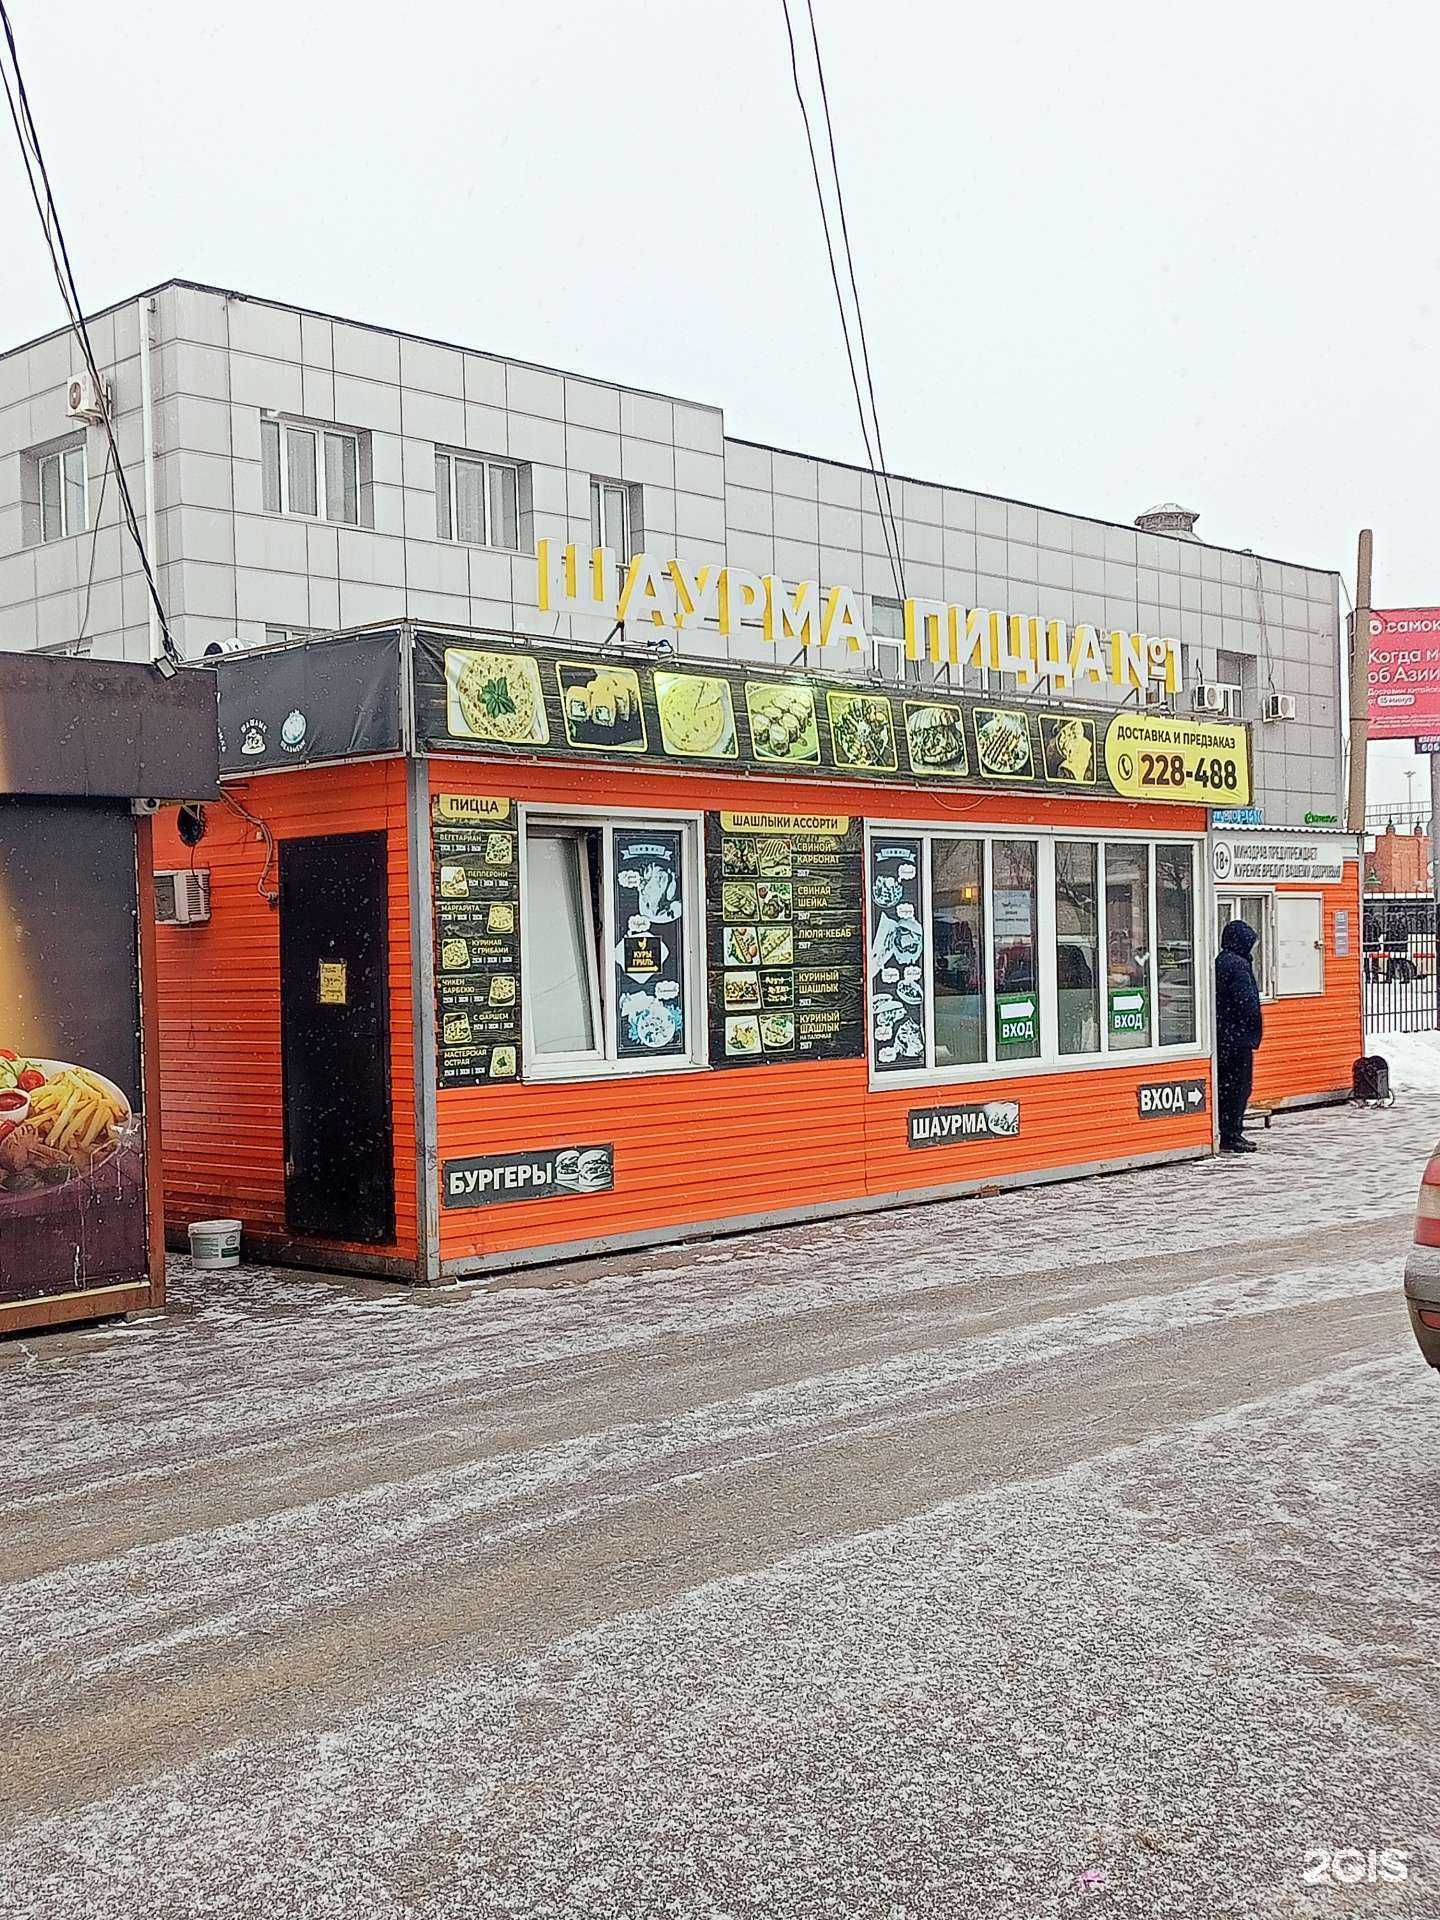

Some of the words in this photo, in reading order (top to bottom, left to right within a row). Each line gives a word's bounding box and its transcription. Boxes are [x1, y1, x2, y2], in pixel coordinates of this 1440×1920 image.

[537, 537, 870, 652] ШАУРМА
[904, 597, 1109, 690] ПИЦЦА
[1111, 629, 1182, 693] №1
[1368, 648, 1422, 665] Когда
[1368, 666, 1391, 683] об
[1393, 666, 1440, 683] Азии
[1117, 725, 1171, 743] ДОСТАВКА
[1173, 732, 1181, 744] И
[1183, 733, 1236, 750] ПРЕДЗАКАЗ
[1140, 754, 1237, 790] 228-488
[449, 798, 499, 815] ПИЦЦА
[732, 814, 790, 829] ШАШЛЫКИ
[793, 816, 838, 830] АССОРТИ
[797, 841, 832, 852] СВИНОЙ
[797, 855, 840, 864] КАРБОНАТ
[1215, 851, 1229, 870] 18+
[467, 870, 509, 879] ПЕППЕРОНИ
[797, 886, 832, 896] СВИНАЯ
[441, 904, 480, 912] МАРГАРИТА
[798, 897, 828, 907] ШЕЙКА
[798, 928, 852, 939] ЛЮЛЯ-КЕБАБ
[633, 950, 653, 958] КУРЫ
[632, 958, 654, 966] ГРИЛЬ
[442, 978, 465, 986] ЧИКЕН
[798, 969, 840, 982] КУРИНЫЙ
[798, 983, 839, 994] ШАШЛЫК
[799, 1010, 840, 1023] КУРИНЫЙ
[1113, 1012, 1143, 1030] ВХОД
[799, 1022, 840, 1034] ШАШЛЫК
[1002, 1020, 1035, 1039] ВХОД
[444, 1048, 487, 1059] МАСТЕРСКАЯ
[444, 1058, 470, 1067] ОСТРАЯ
[1139, 1087, 1185, 1112] ВХОД
[911, 1112, 988, 1140] ШАУРМА
[449, 1162, 552, 1195] БУРГЕРЫ
